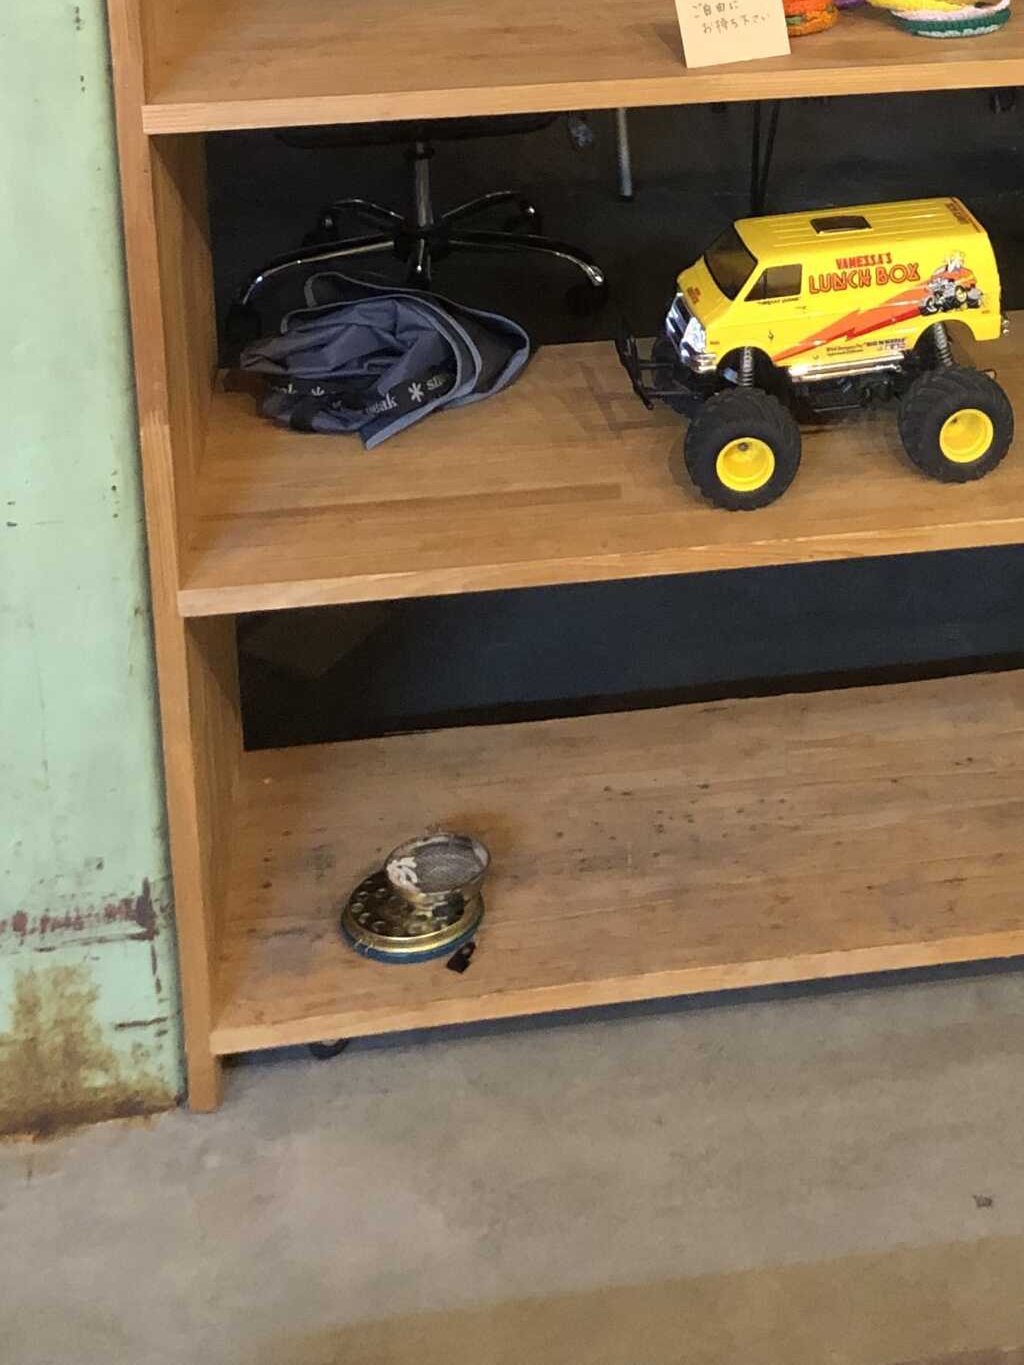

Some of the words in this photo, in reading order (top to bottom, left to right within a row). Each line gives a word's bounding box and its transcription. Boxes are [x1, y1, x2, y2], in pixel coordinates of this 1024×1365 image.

[835, 252, 893, 270] VANESSA'S
[808, 268, 872, 295] LUNCH
[875, 262, 921, 286] BOX
